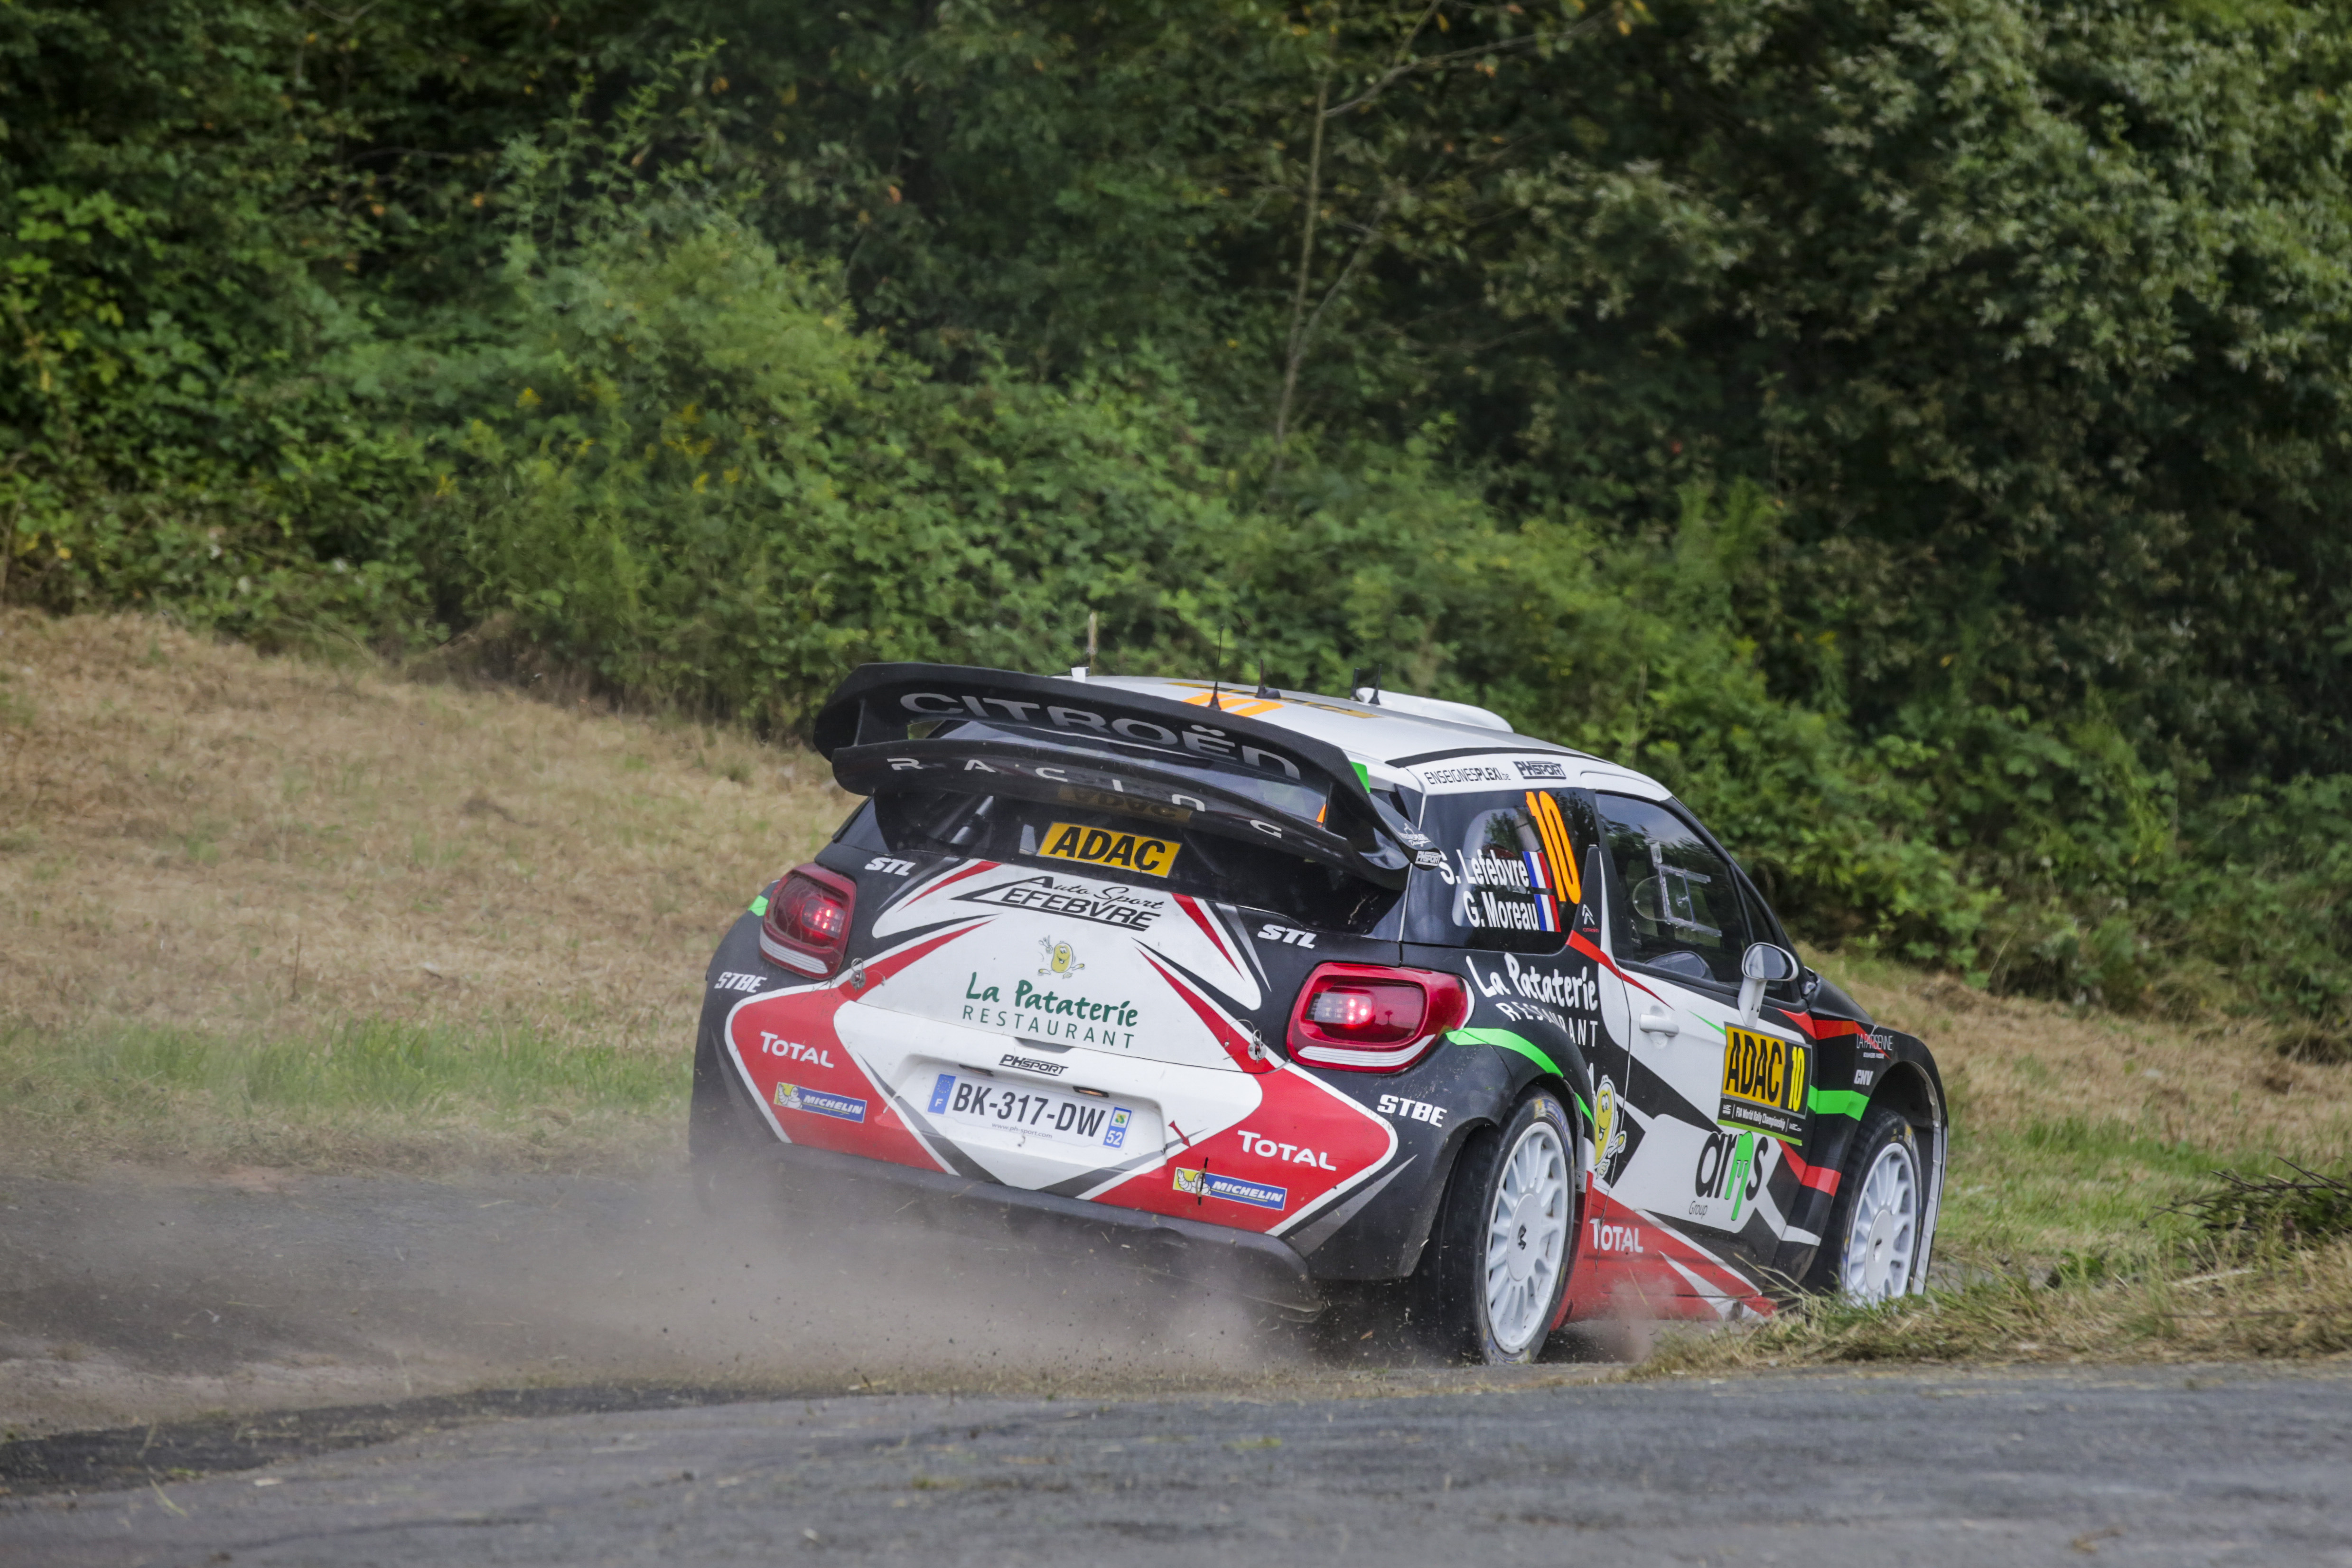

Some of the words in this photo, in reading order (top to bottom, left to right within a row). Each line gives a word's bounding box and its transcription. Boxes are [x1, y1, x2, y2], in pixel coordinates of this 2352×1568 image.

[900, 692, 1301, 780] CITROËN
[887, 758, 1281, 838] RACING
[1049, 826, 1166, 871] ADAC
[1525, 791, 1581, 904] 10
[865, 857, 916, 876] STL
[1439, 850, 1461, 885] S.
[1456, 849, 1530, 887] Lefebvre
[1020, 876, 1090, 895] Auto
[1094, 887, 1164, 909] Sport
[1463, 890, 1485, 928] G.
[1481, 891, 1540, 931] Moreau
[1258, 924, 1318, 948] STL
[714, 971, 767, 993] STBE
[966, 972, 1000, 1002] La
[1466, 956, 1511, 998] La
[1504, 952, 1598, 1011] Pataterie
[962, 1005, 1134, 1048] RESTAURANT
[760, 1031, 834, 1068] TOTAL
[1725, 1032, 1783, 1103] ADAC
[1788, 1046, 1804, 1111] 10
[803, 1094, 863, 1114] MICHELIN
[935, 1099, 943, 1107] F
[952, 1083, 1106, 1137] BK-317-DW
[1377, 1094, 1447, 1128] STBE
[992, 1122, 1052, 1139] www.ph-sport.com
[1106, 1130, 1123, 1145] 52
[1238, 1130, 1337, 1171] TOTAL
[1211, 1180, 1283, 1203] MICHELIN
[1689, 1200, 1707, 1219] Group
[1589, 1218, 1643, 1253] TOTAL
